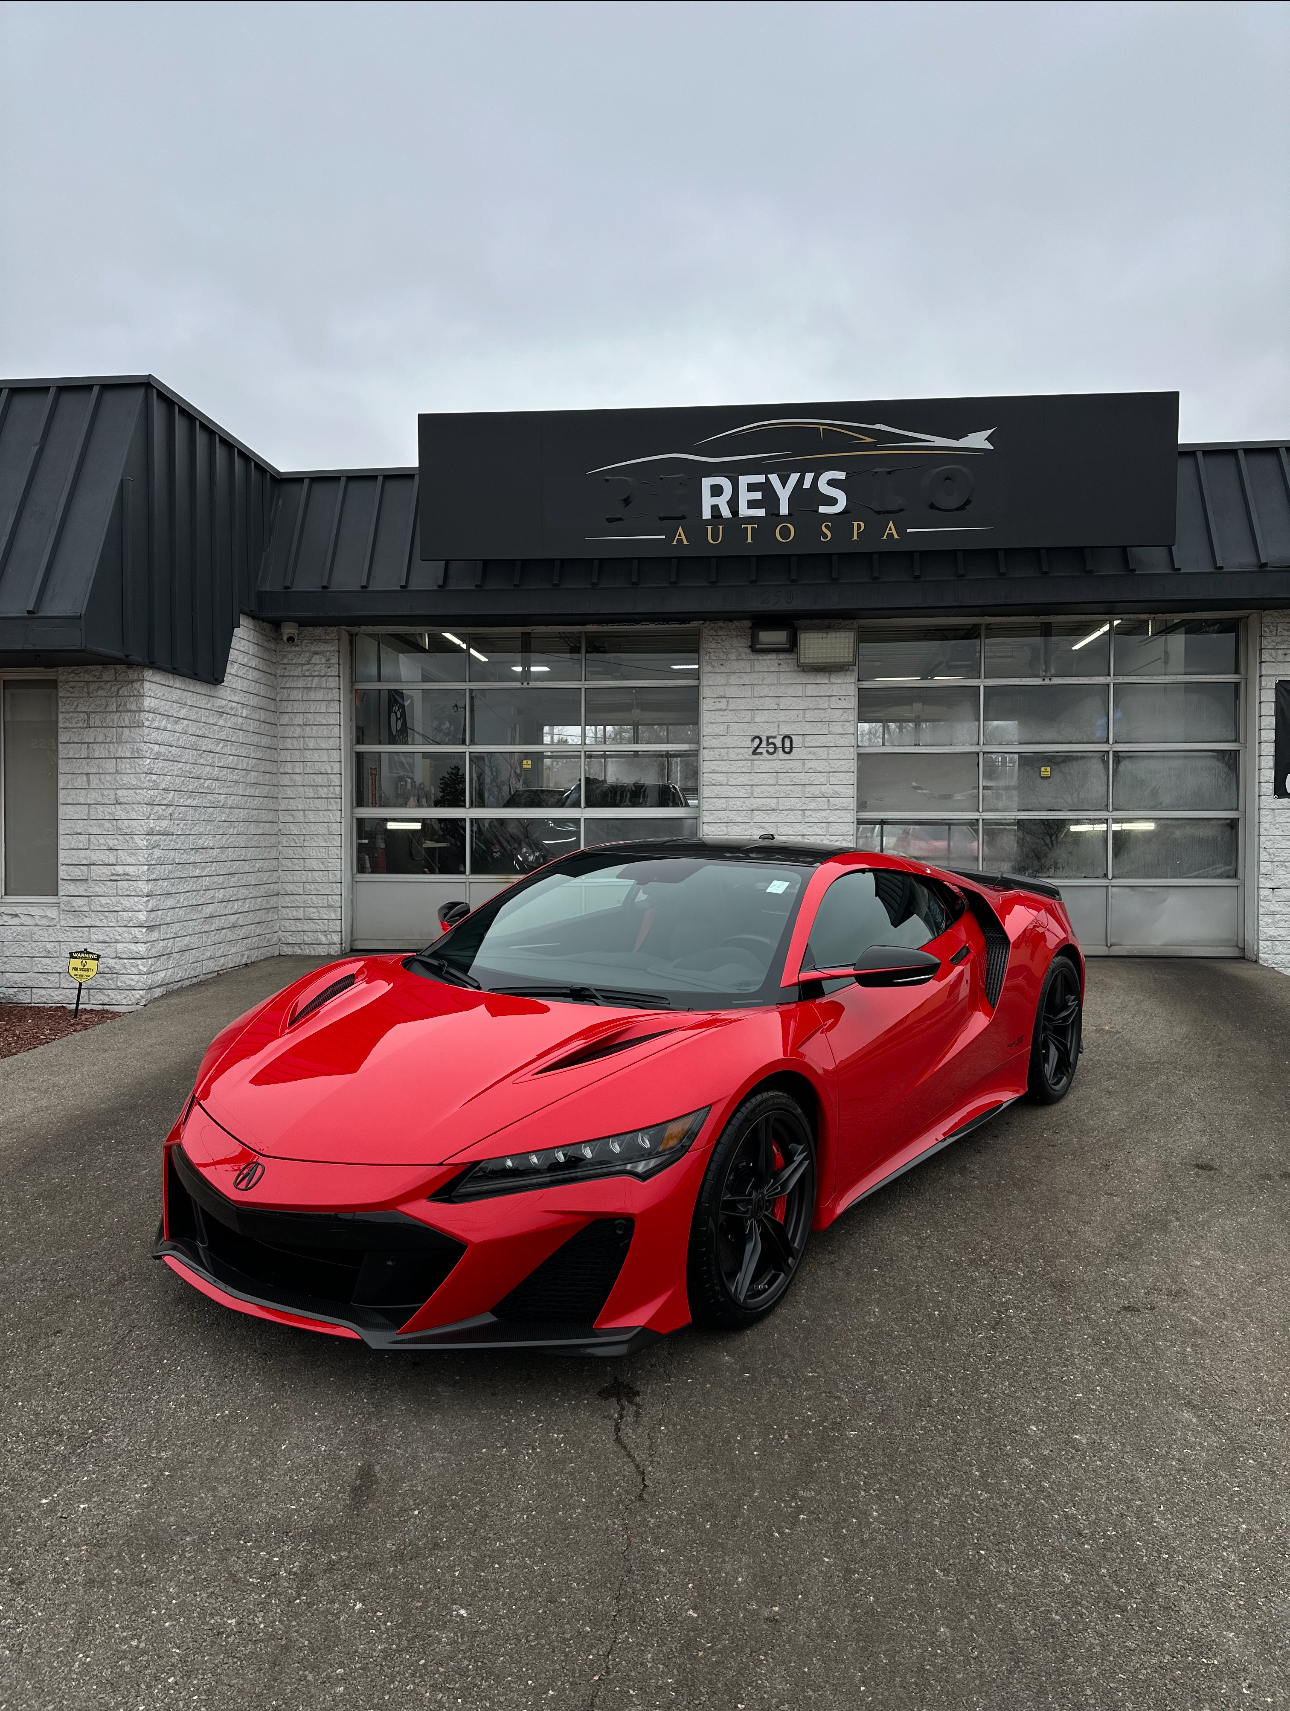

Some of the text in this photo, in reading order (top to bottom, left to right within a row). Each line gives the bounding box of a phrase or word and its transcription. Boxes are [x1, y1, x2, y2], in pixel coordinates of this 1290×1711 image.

[701, 470, 848, 520] REY'S
[671, 520, 900, 545] AUTO SPA
[750, 735, 794, 756] 250
